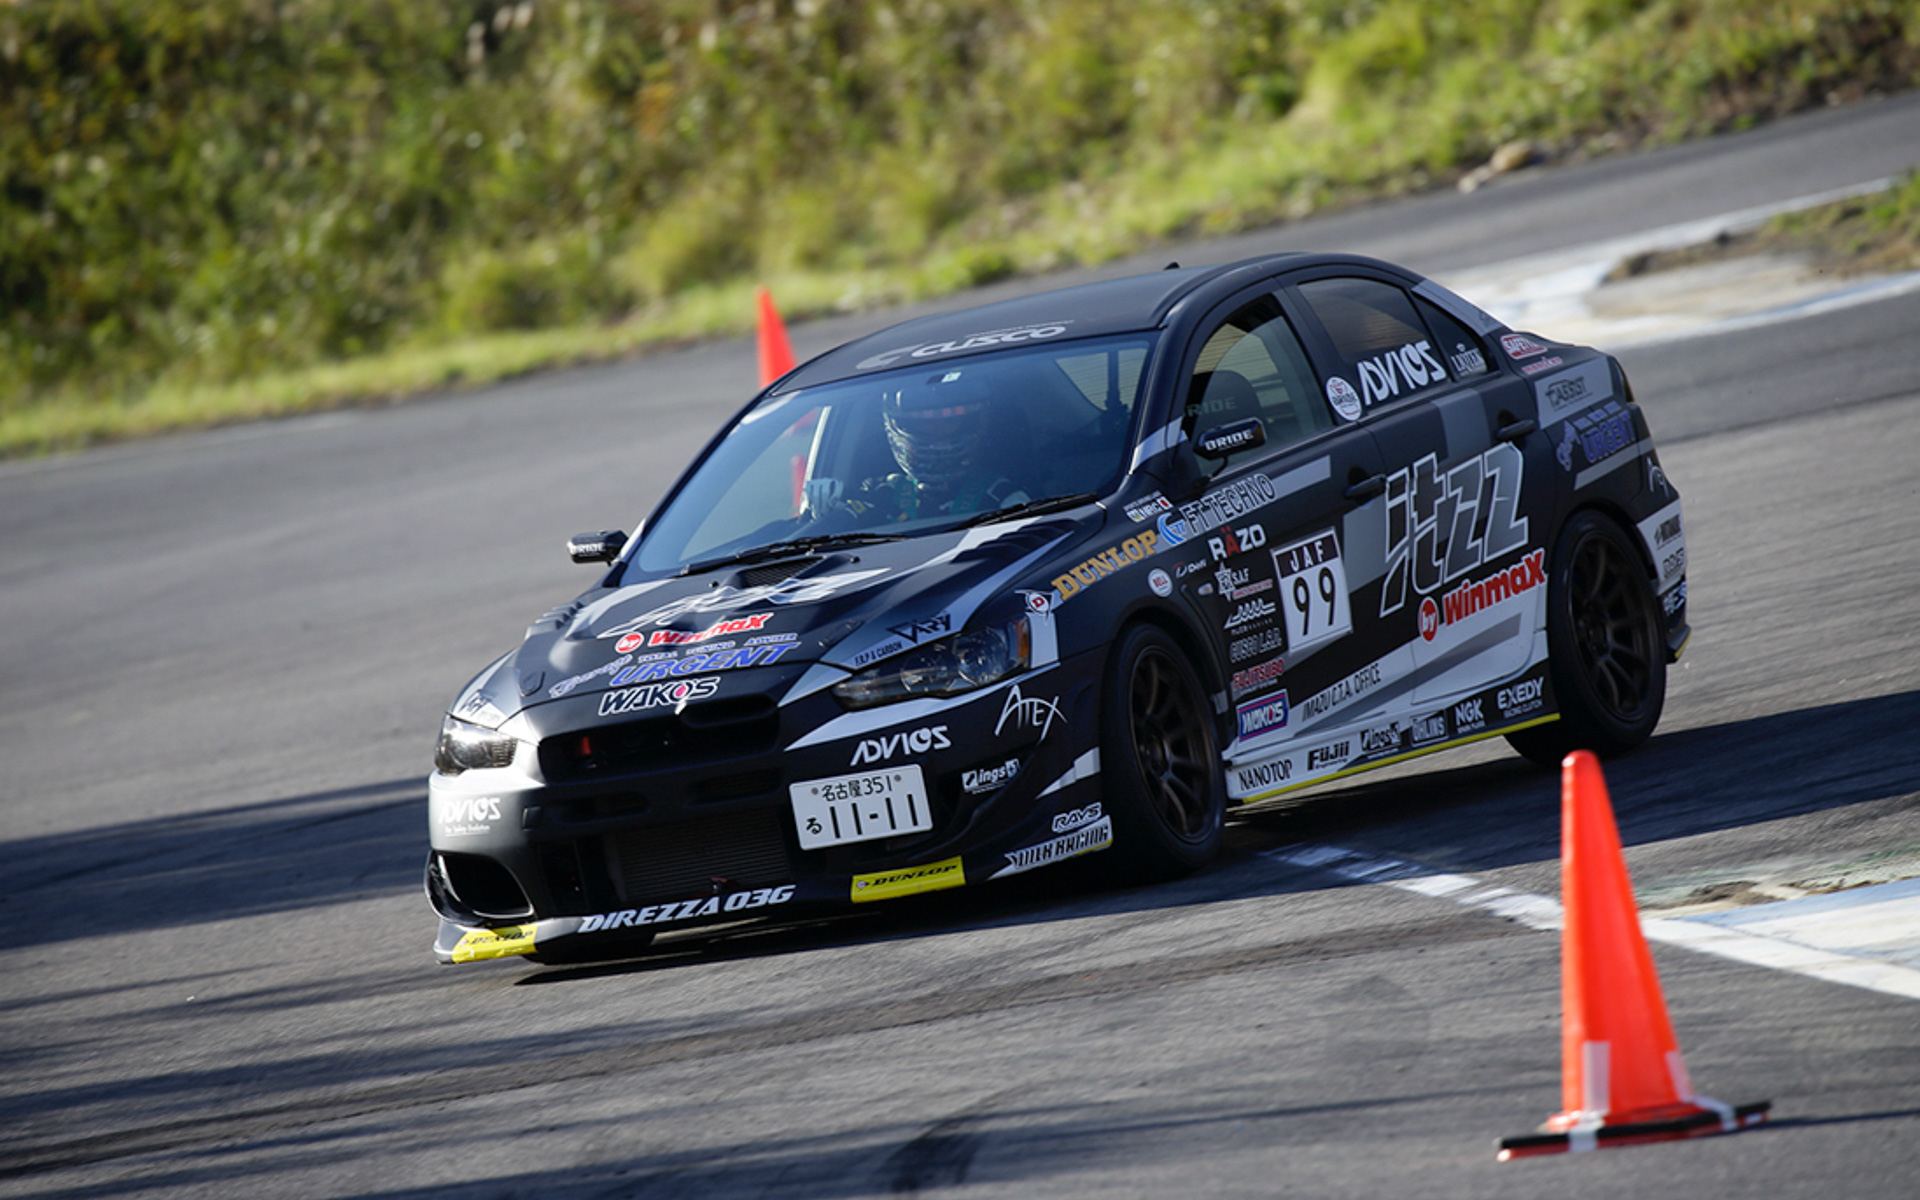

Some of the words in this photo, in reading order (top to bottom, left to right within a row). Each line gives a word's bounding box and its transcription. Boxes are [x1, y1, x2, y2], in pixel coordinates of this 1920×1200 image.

[1186, 397, 1236, 417] RIDE
[1053, 529, 1157, 600] DUNLOP
[1289, 540, 1324, 573] JAF
[1293, 566, 1335, 636] 99
[609, 642, 801, 687] URGENT
[1497, 677, 1545, 709] EXEDY
[1454, 698, 1484, 726] NGK
[1238, 758, 1293, 791] NANOTOP
[1053, 803, 1102, 832] RAYS
[872, 864, 958, 886] DUNLOP
[576, 897, 721, 935] DIREZZA
